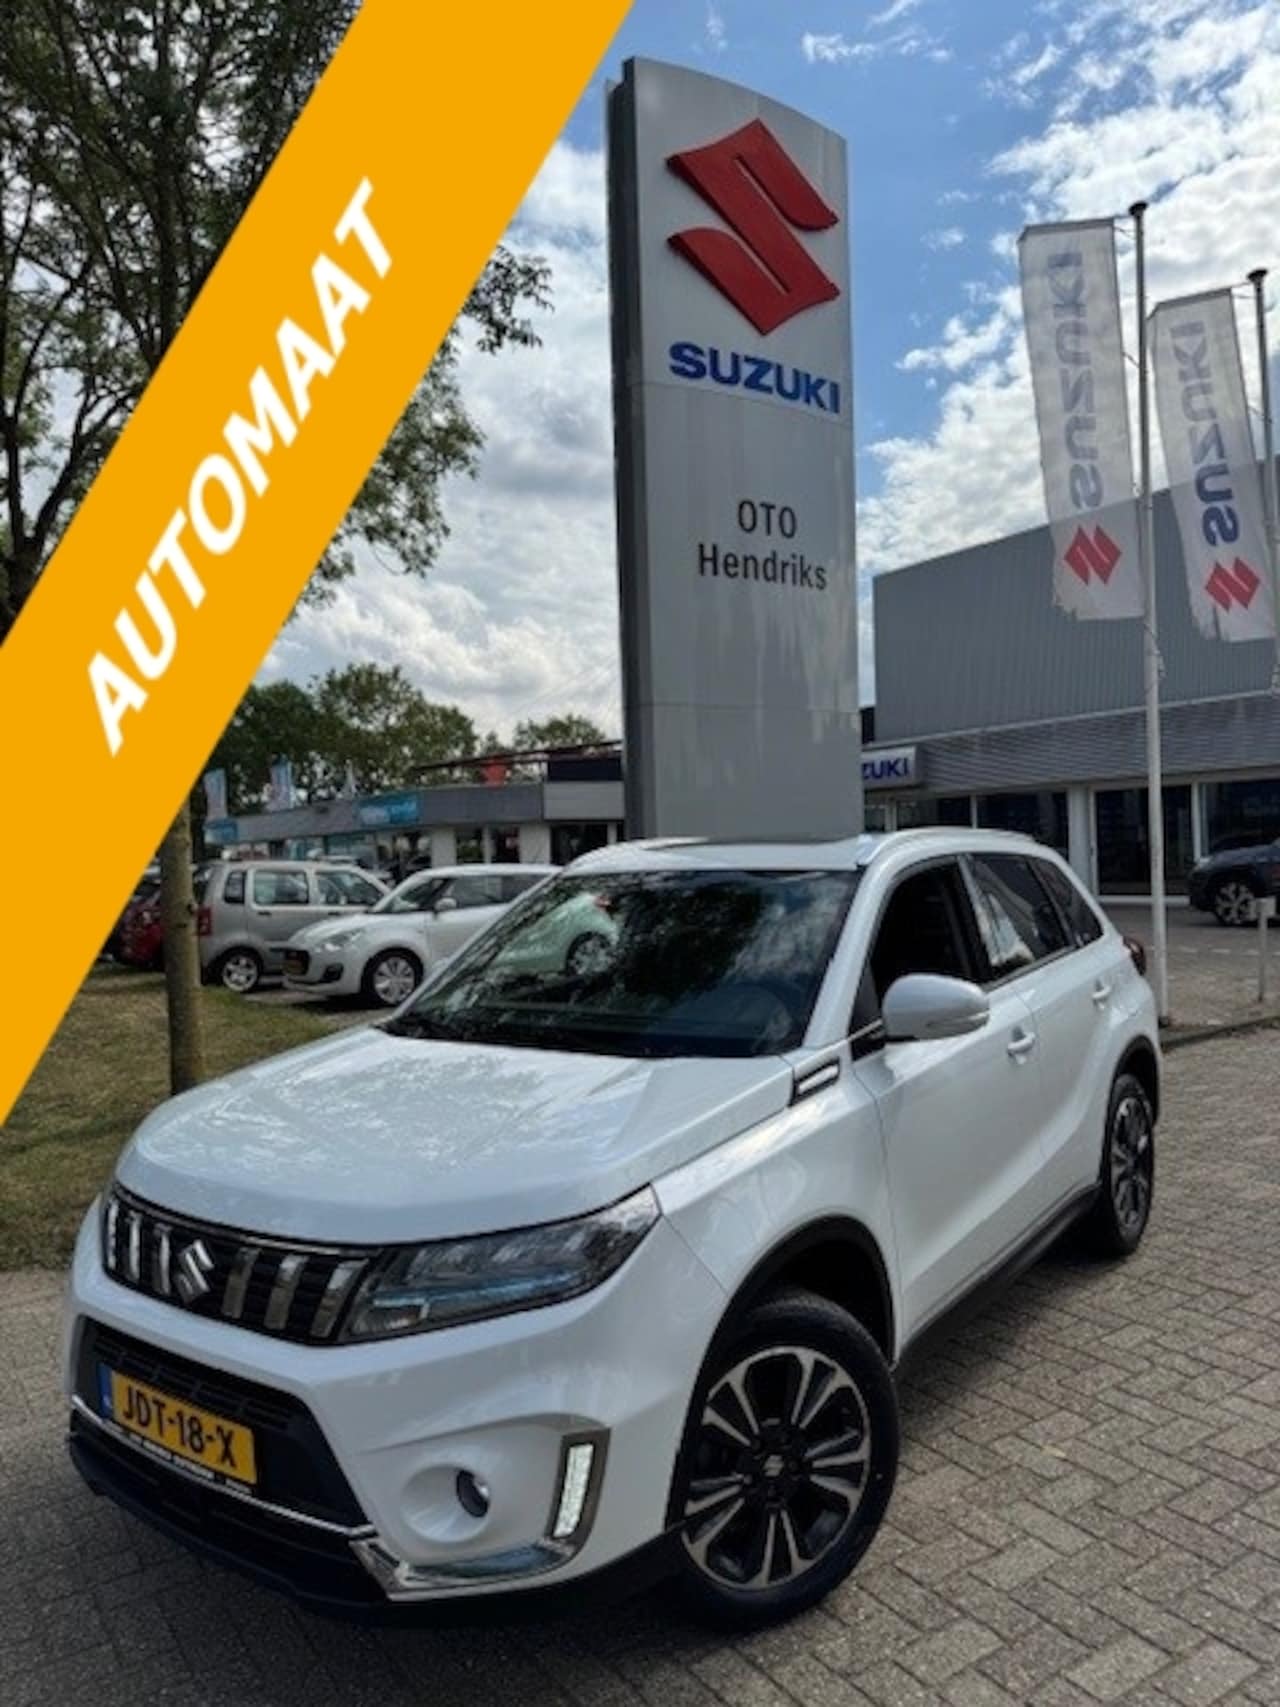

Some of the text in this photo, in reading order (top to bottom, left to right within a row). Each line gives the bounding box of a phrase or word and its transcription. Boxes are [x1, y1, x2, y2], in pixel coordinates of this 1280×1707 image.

[668, 341, 841, 414] SUZUKI
[737, 499, 797, 539] OTO
[697, 543, 827, 590] Hendriks
[123, 1384, 238, 1468] JDT-18-X
